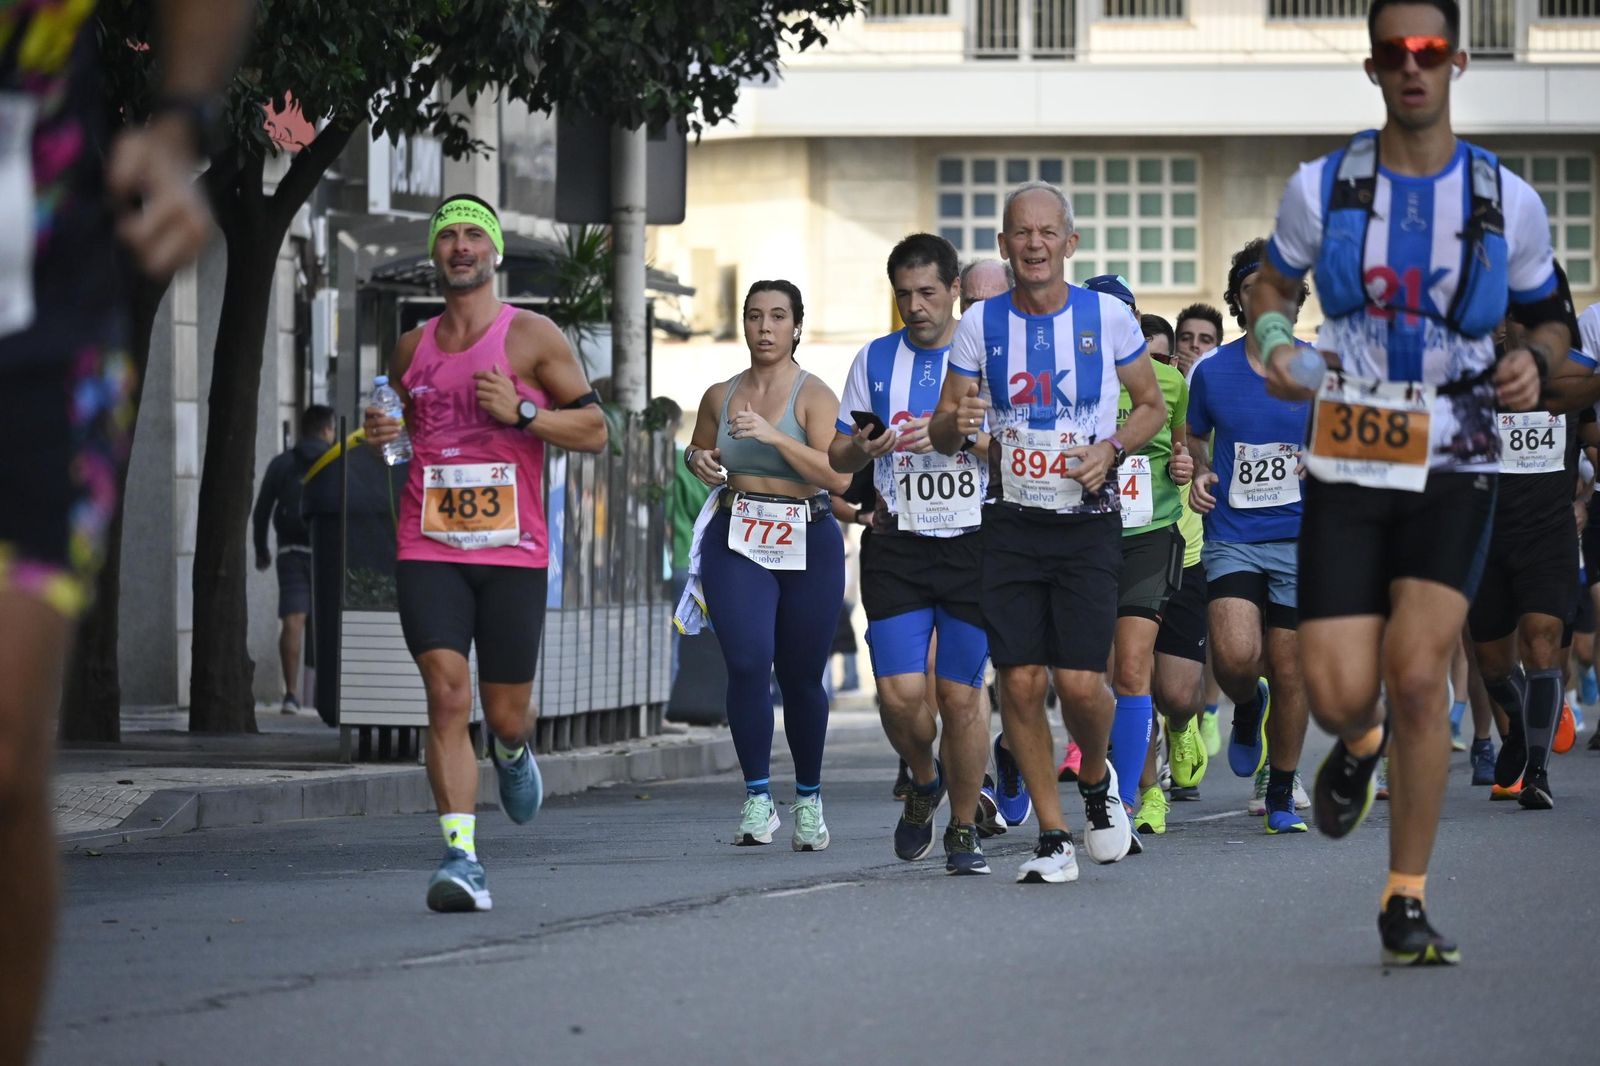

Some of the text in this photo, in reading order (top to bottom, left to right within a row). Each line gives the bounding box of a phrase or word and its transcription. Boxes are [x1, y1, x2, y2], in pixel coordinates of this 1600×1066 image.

[1364, 265, 1452, 326] 21K
[1009, 369, 1073, 407] 21K
[1331, 404, 1409, 449] 368
[1509, 428, 1555, 451] 864
[1011, 448, 1068, 479] 894
[1238, 457, 1286, 485] 828
[899, 471, 975, 501] 1008
[1020, 489, 1055, 503] Huelva
[1121, 475, 1139, 500] 4
[1246, 493, 1278, 502] Huelva
[438, 487, 500, 519] 483
[742, 518, 793, 545] 772
[917, 513, 954, 524] Huelva
